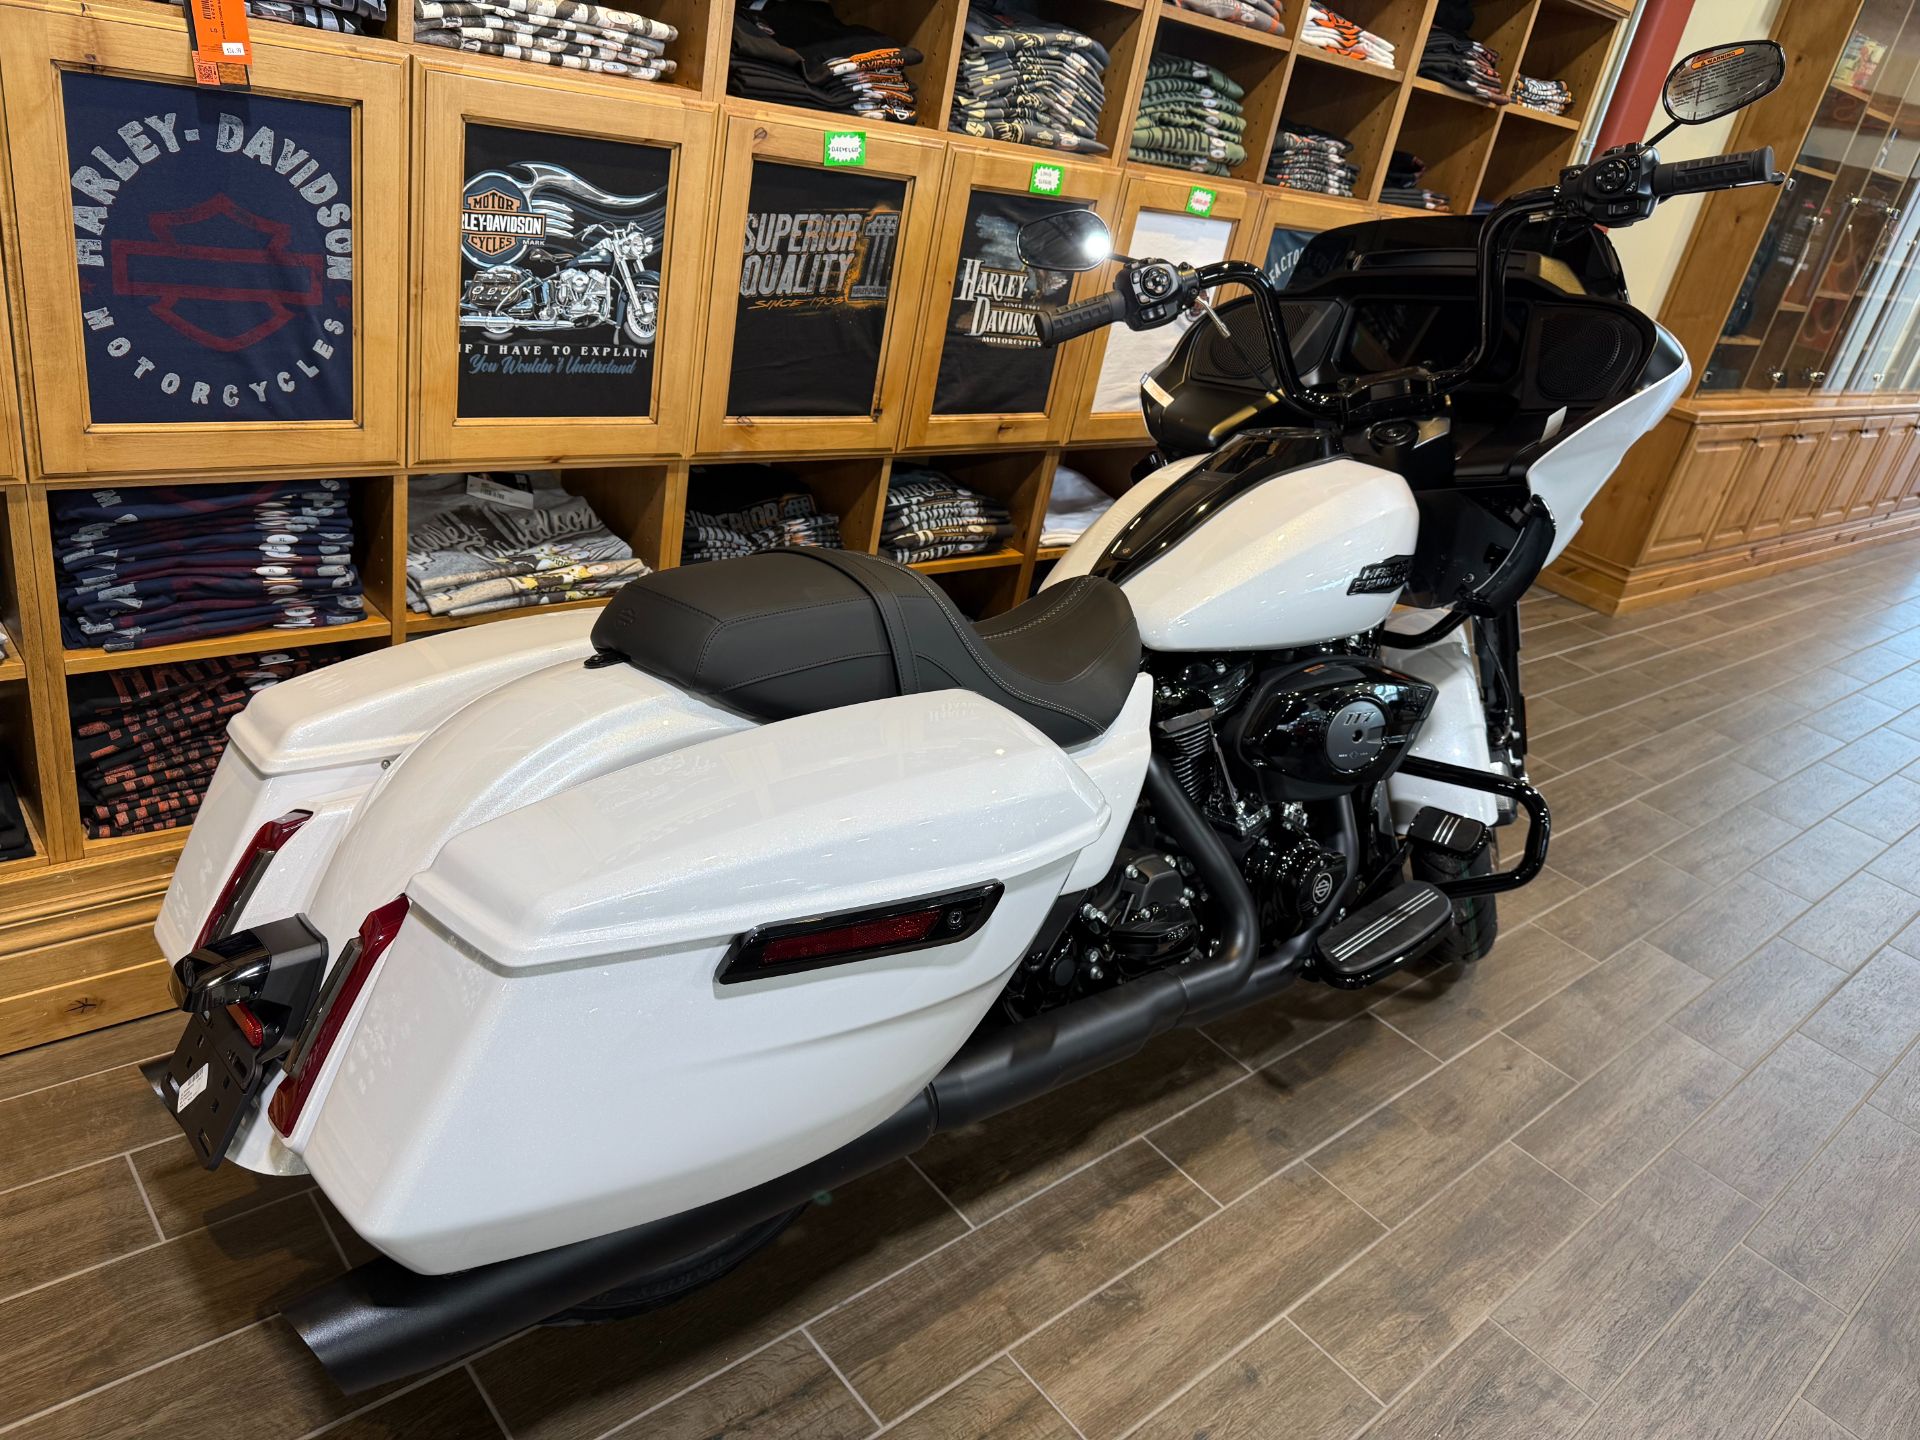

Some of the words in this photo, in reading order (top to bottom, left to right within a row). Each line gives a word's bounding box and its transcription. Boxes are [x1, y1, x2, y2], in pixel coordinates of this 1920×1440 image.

[1707, 51, 1736, 64] WARNING
[216, 112, 352, 281] DAVIDSON
[473, 192, 514, 211] MOTOR
[744, 213, 862, 254] SUPERIOR
[471, 236, 513, 254] CYCLES
[740, 252, 856, 298] QUALITY
[747, 299, 807, 311] SINCE
[83, 306, 344, 407] MOTORCYCLES
[459, 343, 473, 355] IF
[484, 344, 489, 355] I
[499, 345, 542, 356] HAVE
[552, 346, 571, 356] TO
[581, 346, 648, 359] EXPLAIN
[469, 354, 499, 375] You
[566, 356, 637, 375] Understand
[1343, 711, 1376, 726] 117
